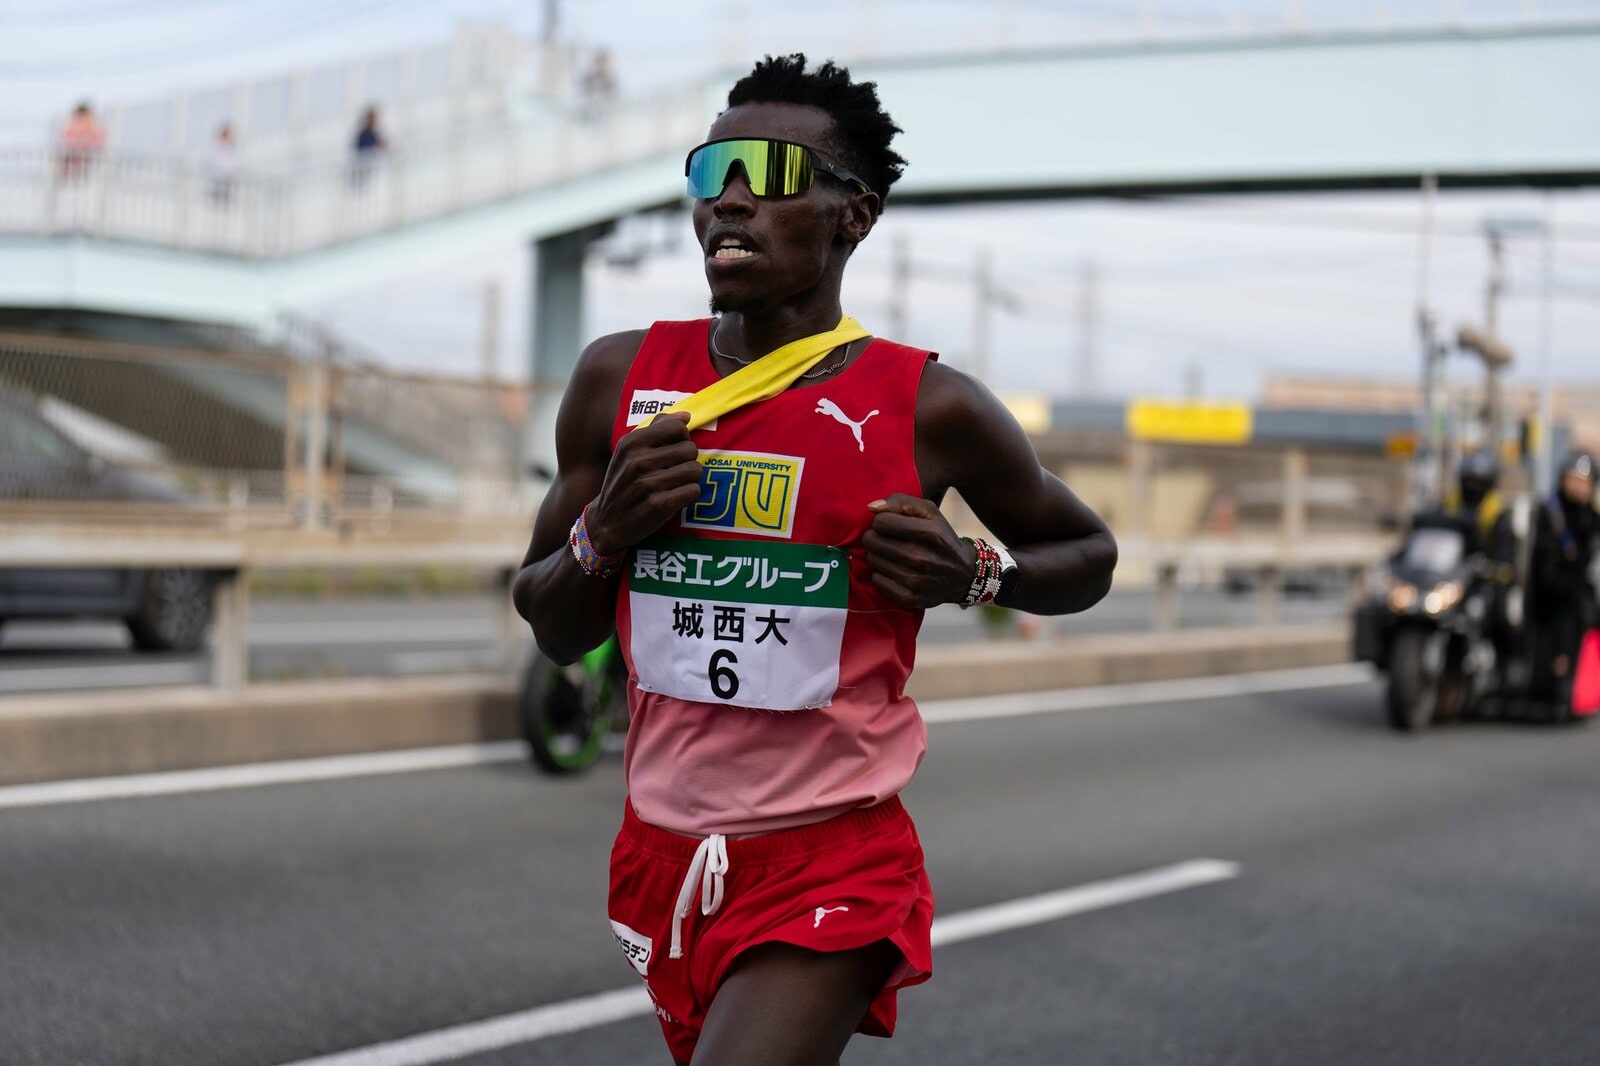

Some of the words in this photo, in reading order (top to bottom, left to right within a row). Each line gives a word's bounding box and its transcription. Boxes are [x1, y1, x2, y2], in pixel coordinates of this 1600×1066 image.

[705, 458, 732, 466] JOSAI
[736, 460, 792, 473] UNIVERSITY
[694, 468, 790, 530] JU
[633, 548, 839, 593] 長谷工グループ
[672, 601, 790, 646] 城西大
[708, 648, 740, 700] 6
